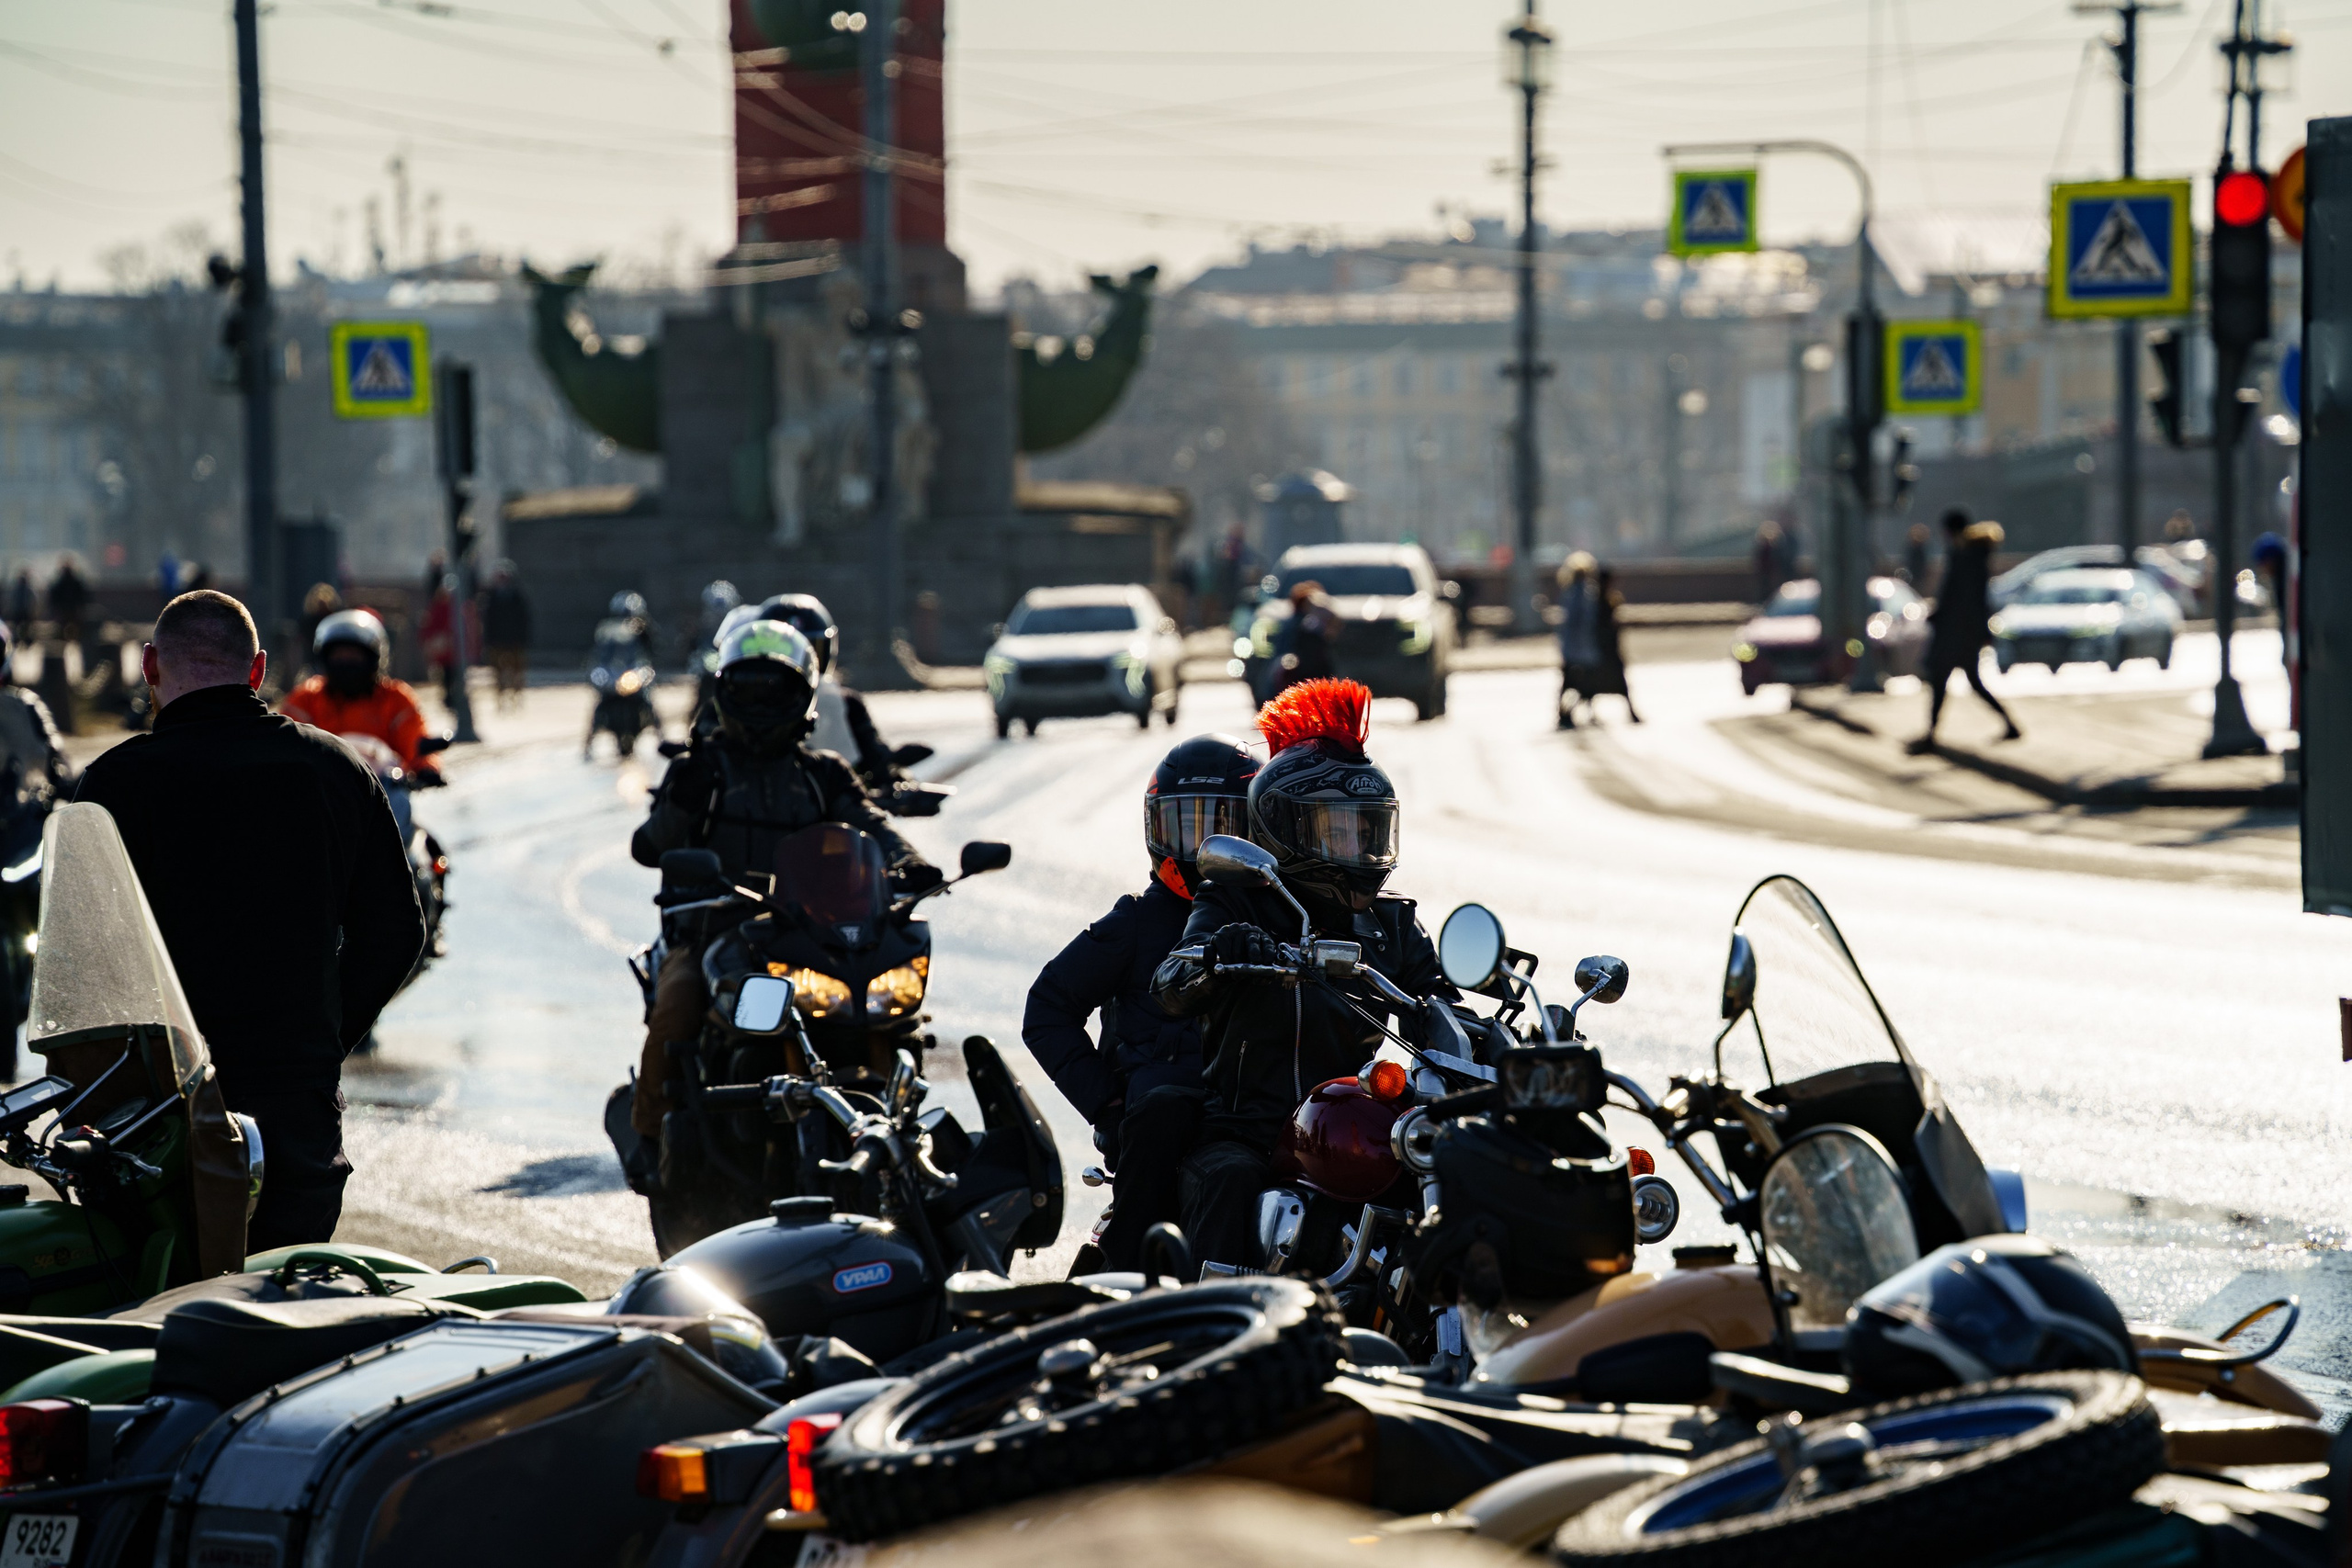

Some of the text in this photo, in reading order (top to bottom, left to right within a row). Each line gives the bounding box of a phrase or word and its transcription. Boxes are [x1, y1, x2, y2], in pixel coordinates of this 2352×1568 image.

[1177, 776, 1225, 785] LS2
[1351, 776, 1382, 790] Airoh
[842, 1267, 885, 1287] УРАЛ
[15, 1519, 66, 1555] 9282
